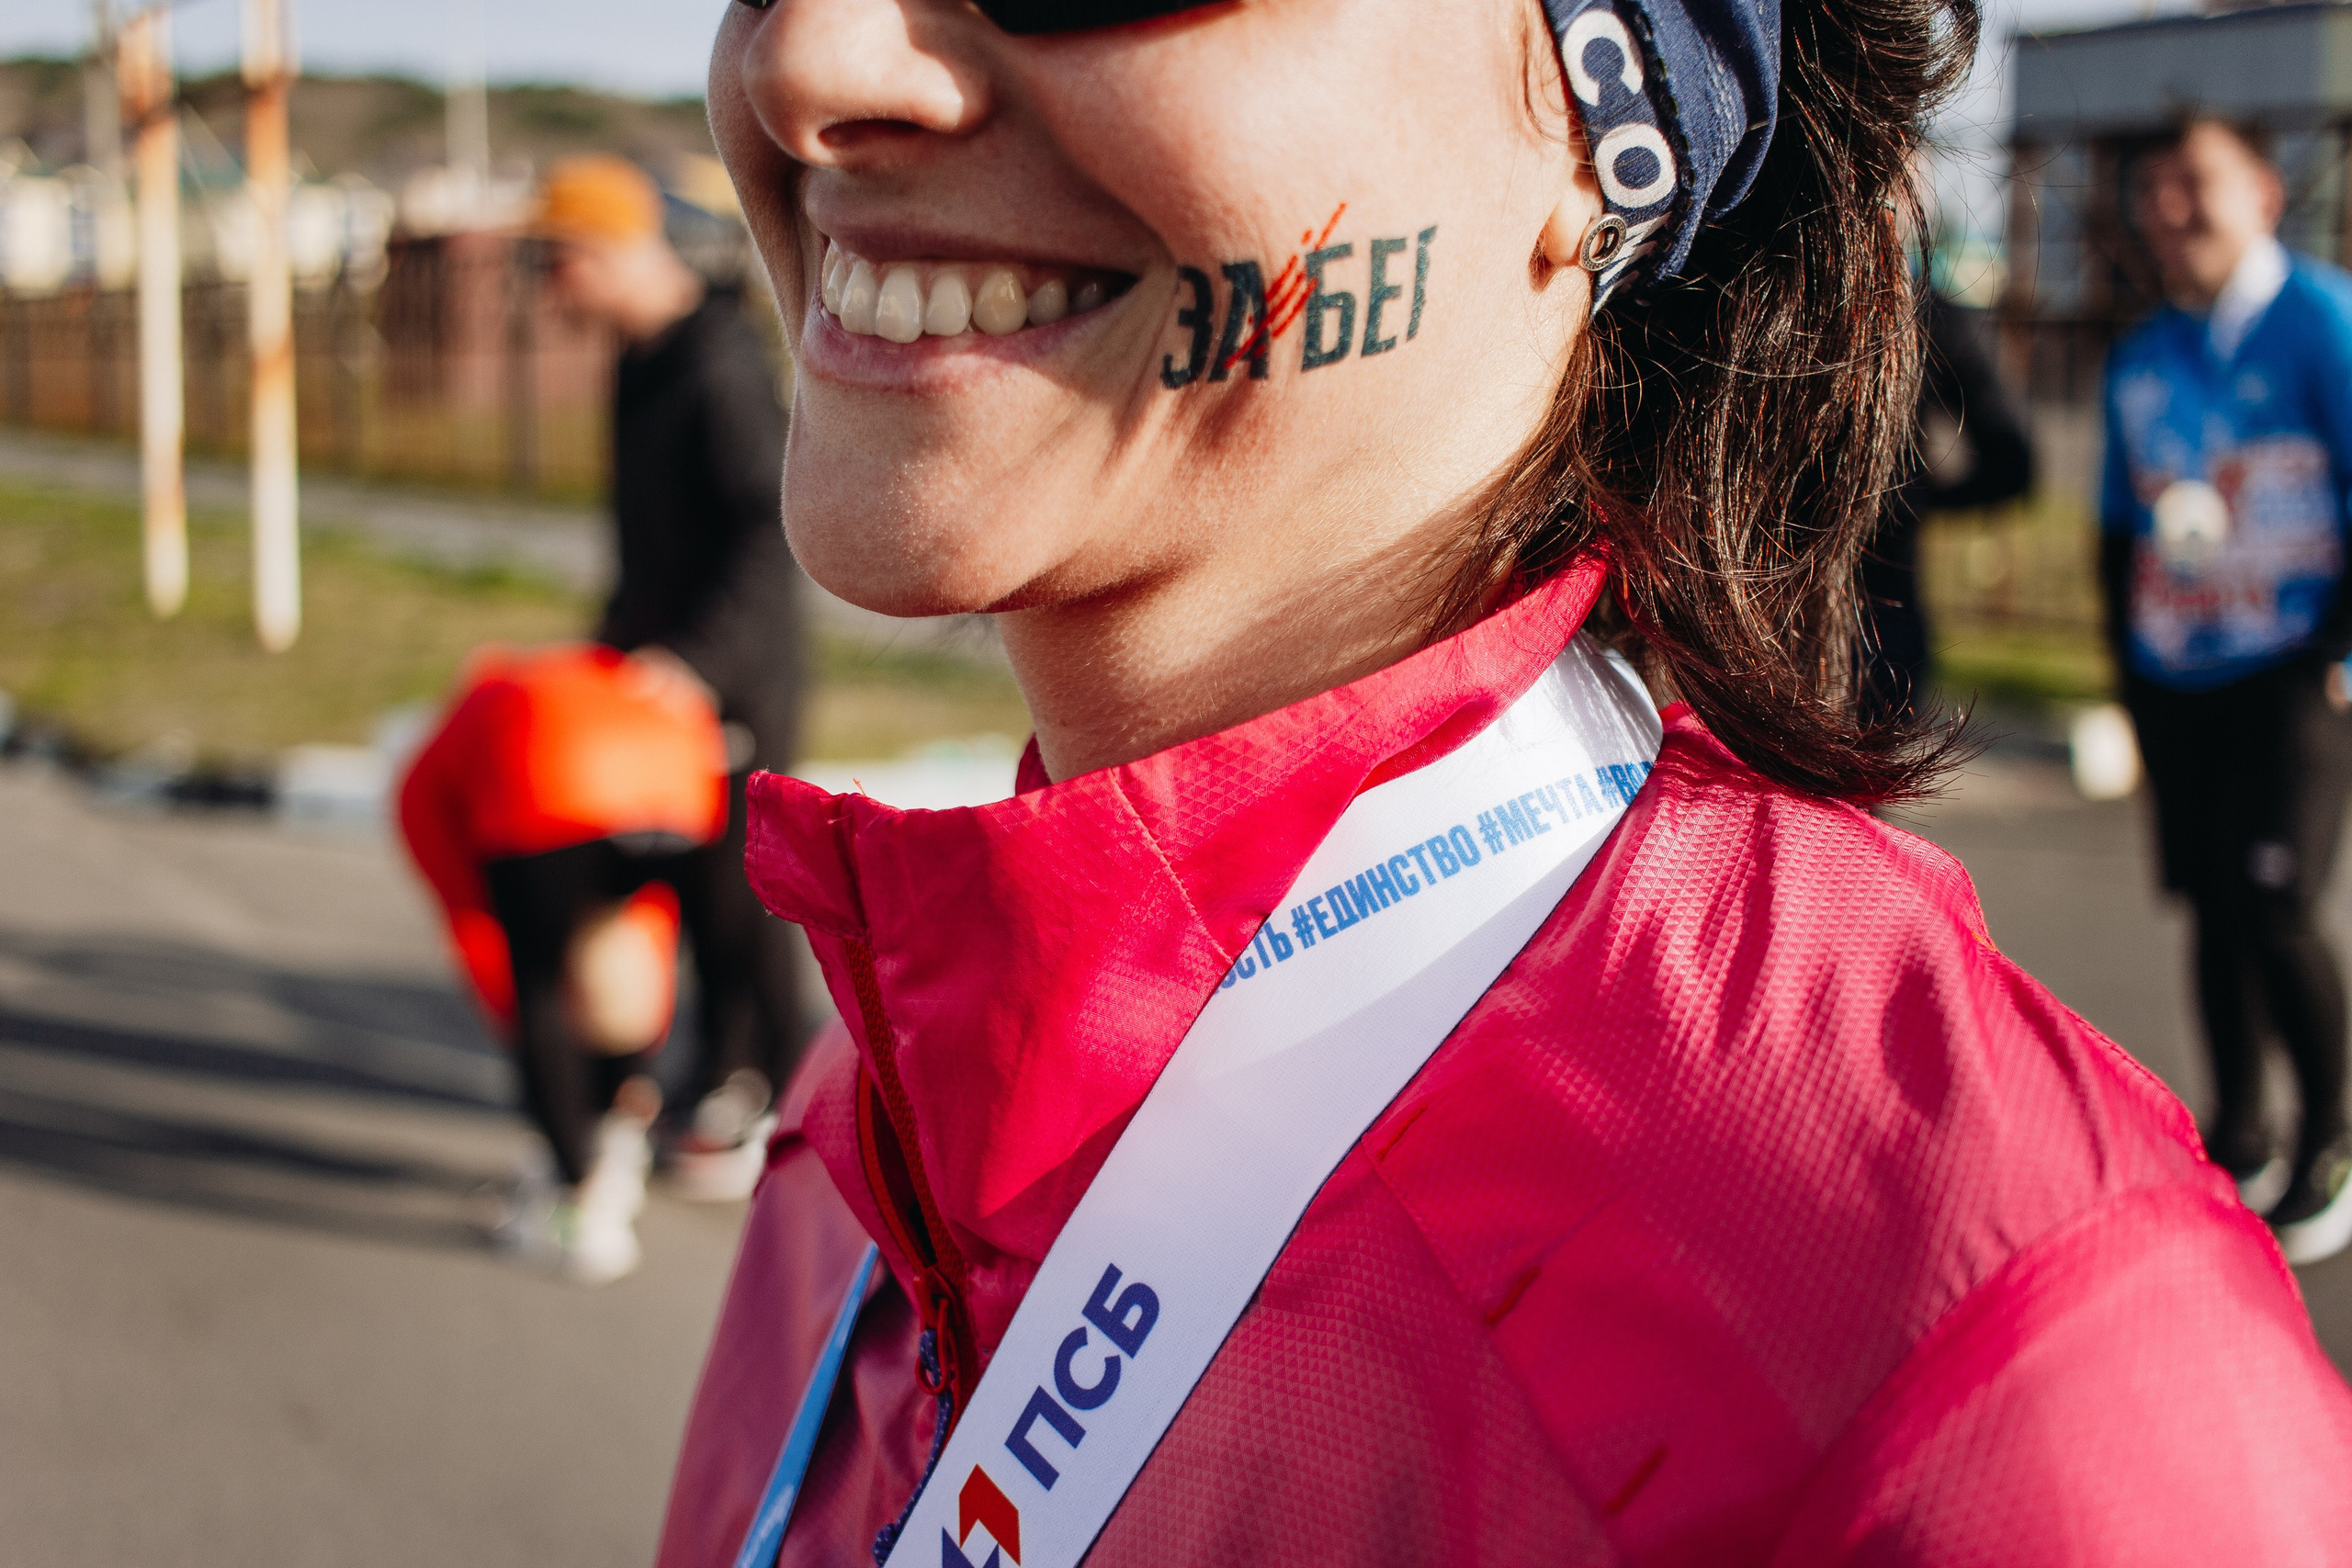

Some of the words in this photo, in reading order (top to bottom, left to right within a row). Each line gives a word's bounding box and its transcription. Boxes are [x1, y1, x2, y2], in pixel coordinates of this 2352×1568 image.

[1290, 824, 1483, 950] #ЕДИНСТВО
[1477, 773, 1603, 856] #МЕЧТА
[1004, 1262, 1160, 1492] ПСБ
